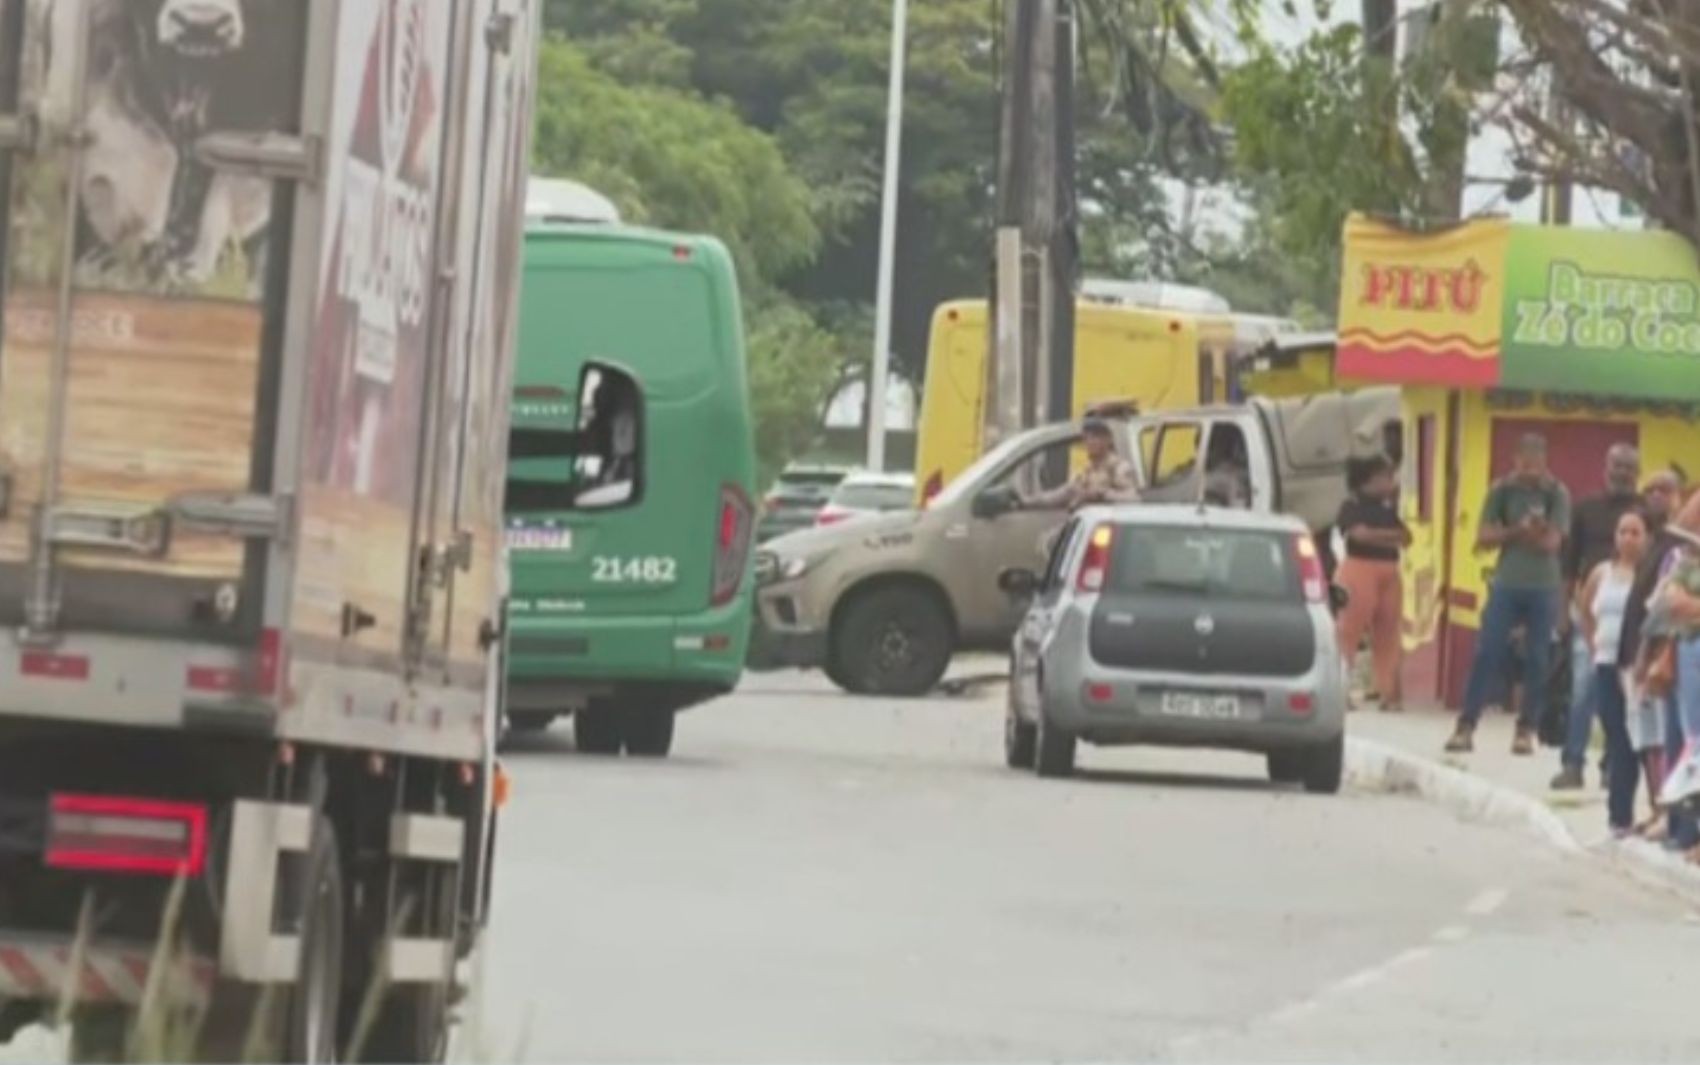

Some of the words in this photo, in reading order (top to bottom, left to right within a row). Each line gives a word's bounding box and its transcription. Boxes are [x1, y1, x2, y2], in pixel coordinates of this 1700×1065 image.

[1360, 258, 1484, 314] PITÚ
[1572, 304, 1626, 350] do
[591, 557, 677, 582] 21482
